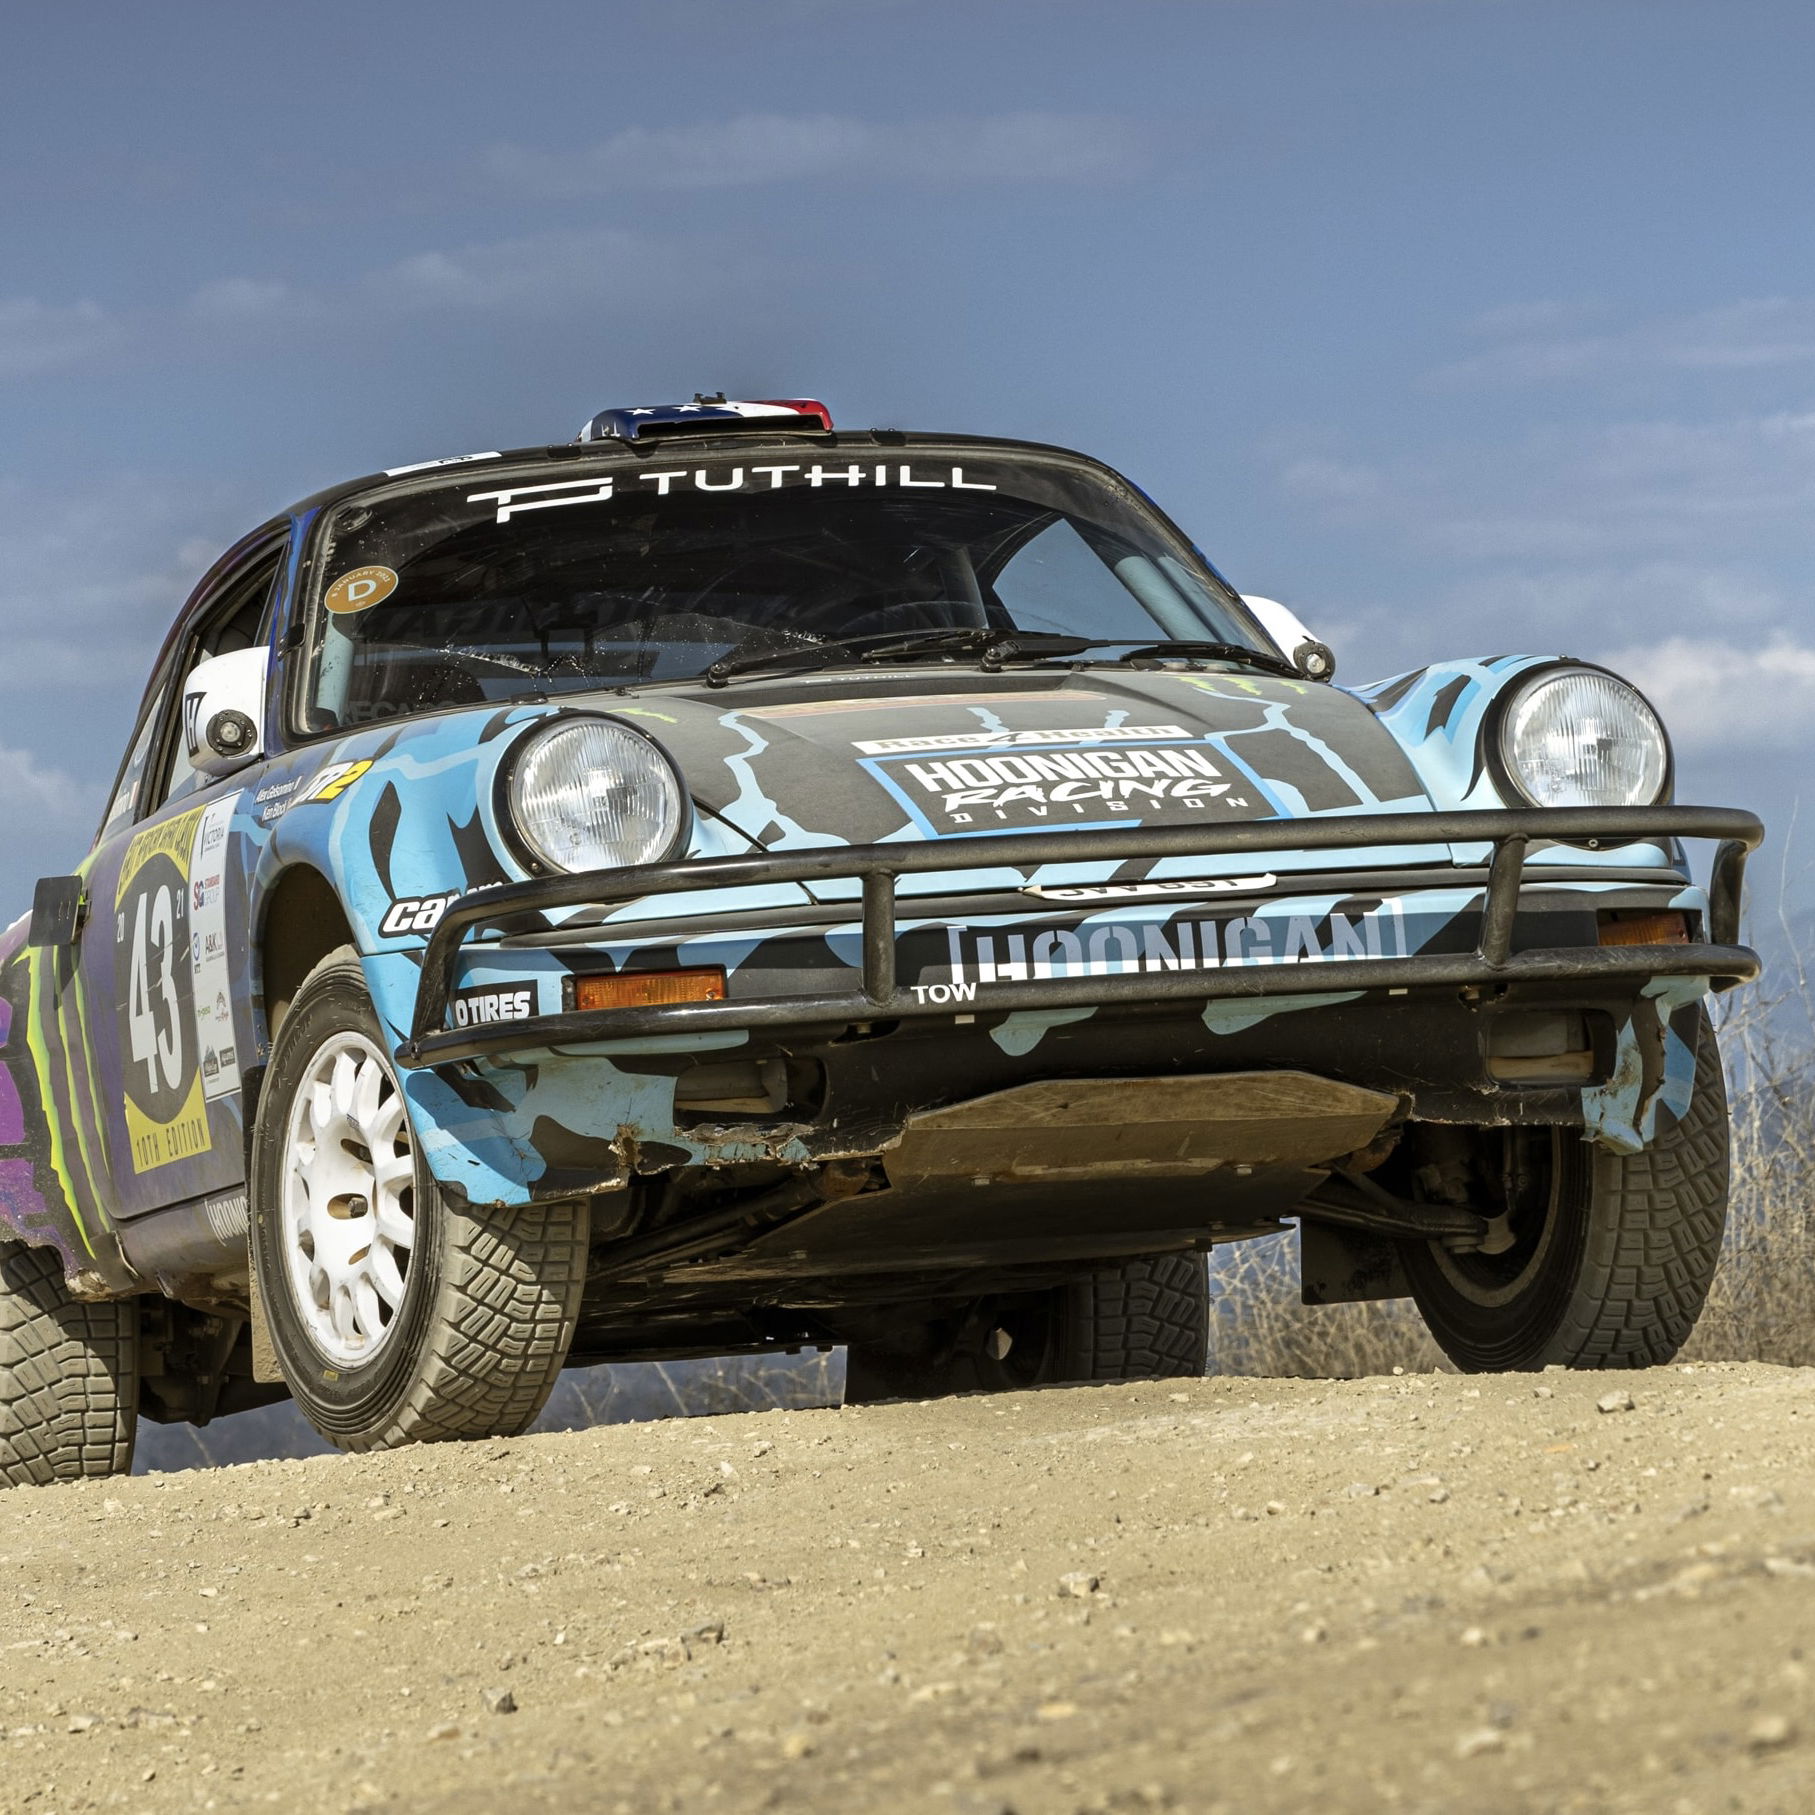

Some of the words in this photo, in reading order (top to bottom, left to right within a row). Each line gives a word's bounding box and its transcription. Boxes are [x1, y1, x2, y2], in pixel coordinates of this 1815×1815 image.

[639, 464, 997, 495] TUTHILL
[348, 580, 377, 602] D
[874, 736, 981, 750] Race
[1032, 726, 1174, 741] Health
[904, 749, 1222, 793] HOONIGAN
[941, 779, 1232, 813] RACING
[949, 797, 1249, 824] DIVISION
[176, 888, 184, 920] 21
[117, 912, 125, 943] 20
[129, 883, 183, 1094] 43
[911, 982, 977, 1004] TOW
[468, 991, 532, 1024] TIRES
[136, 1132, 161, 1168] 10TH
[165, 1117, 206, 1157] EDITION
